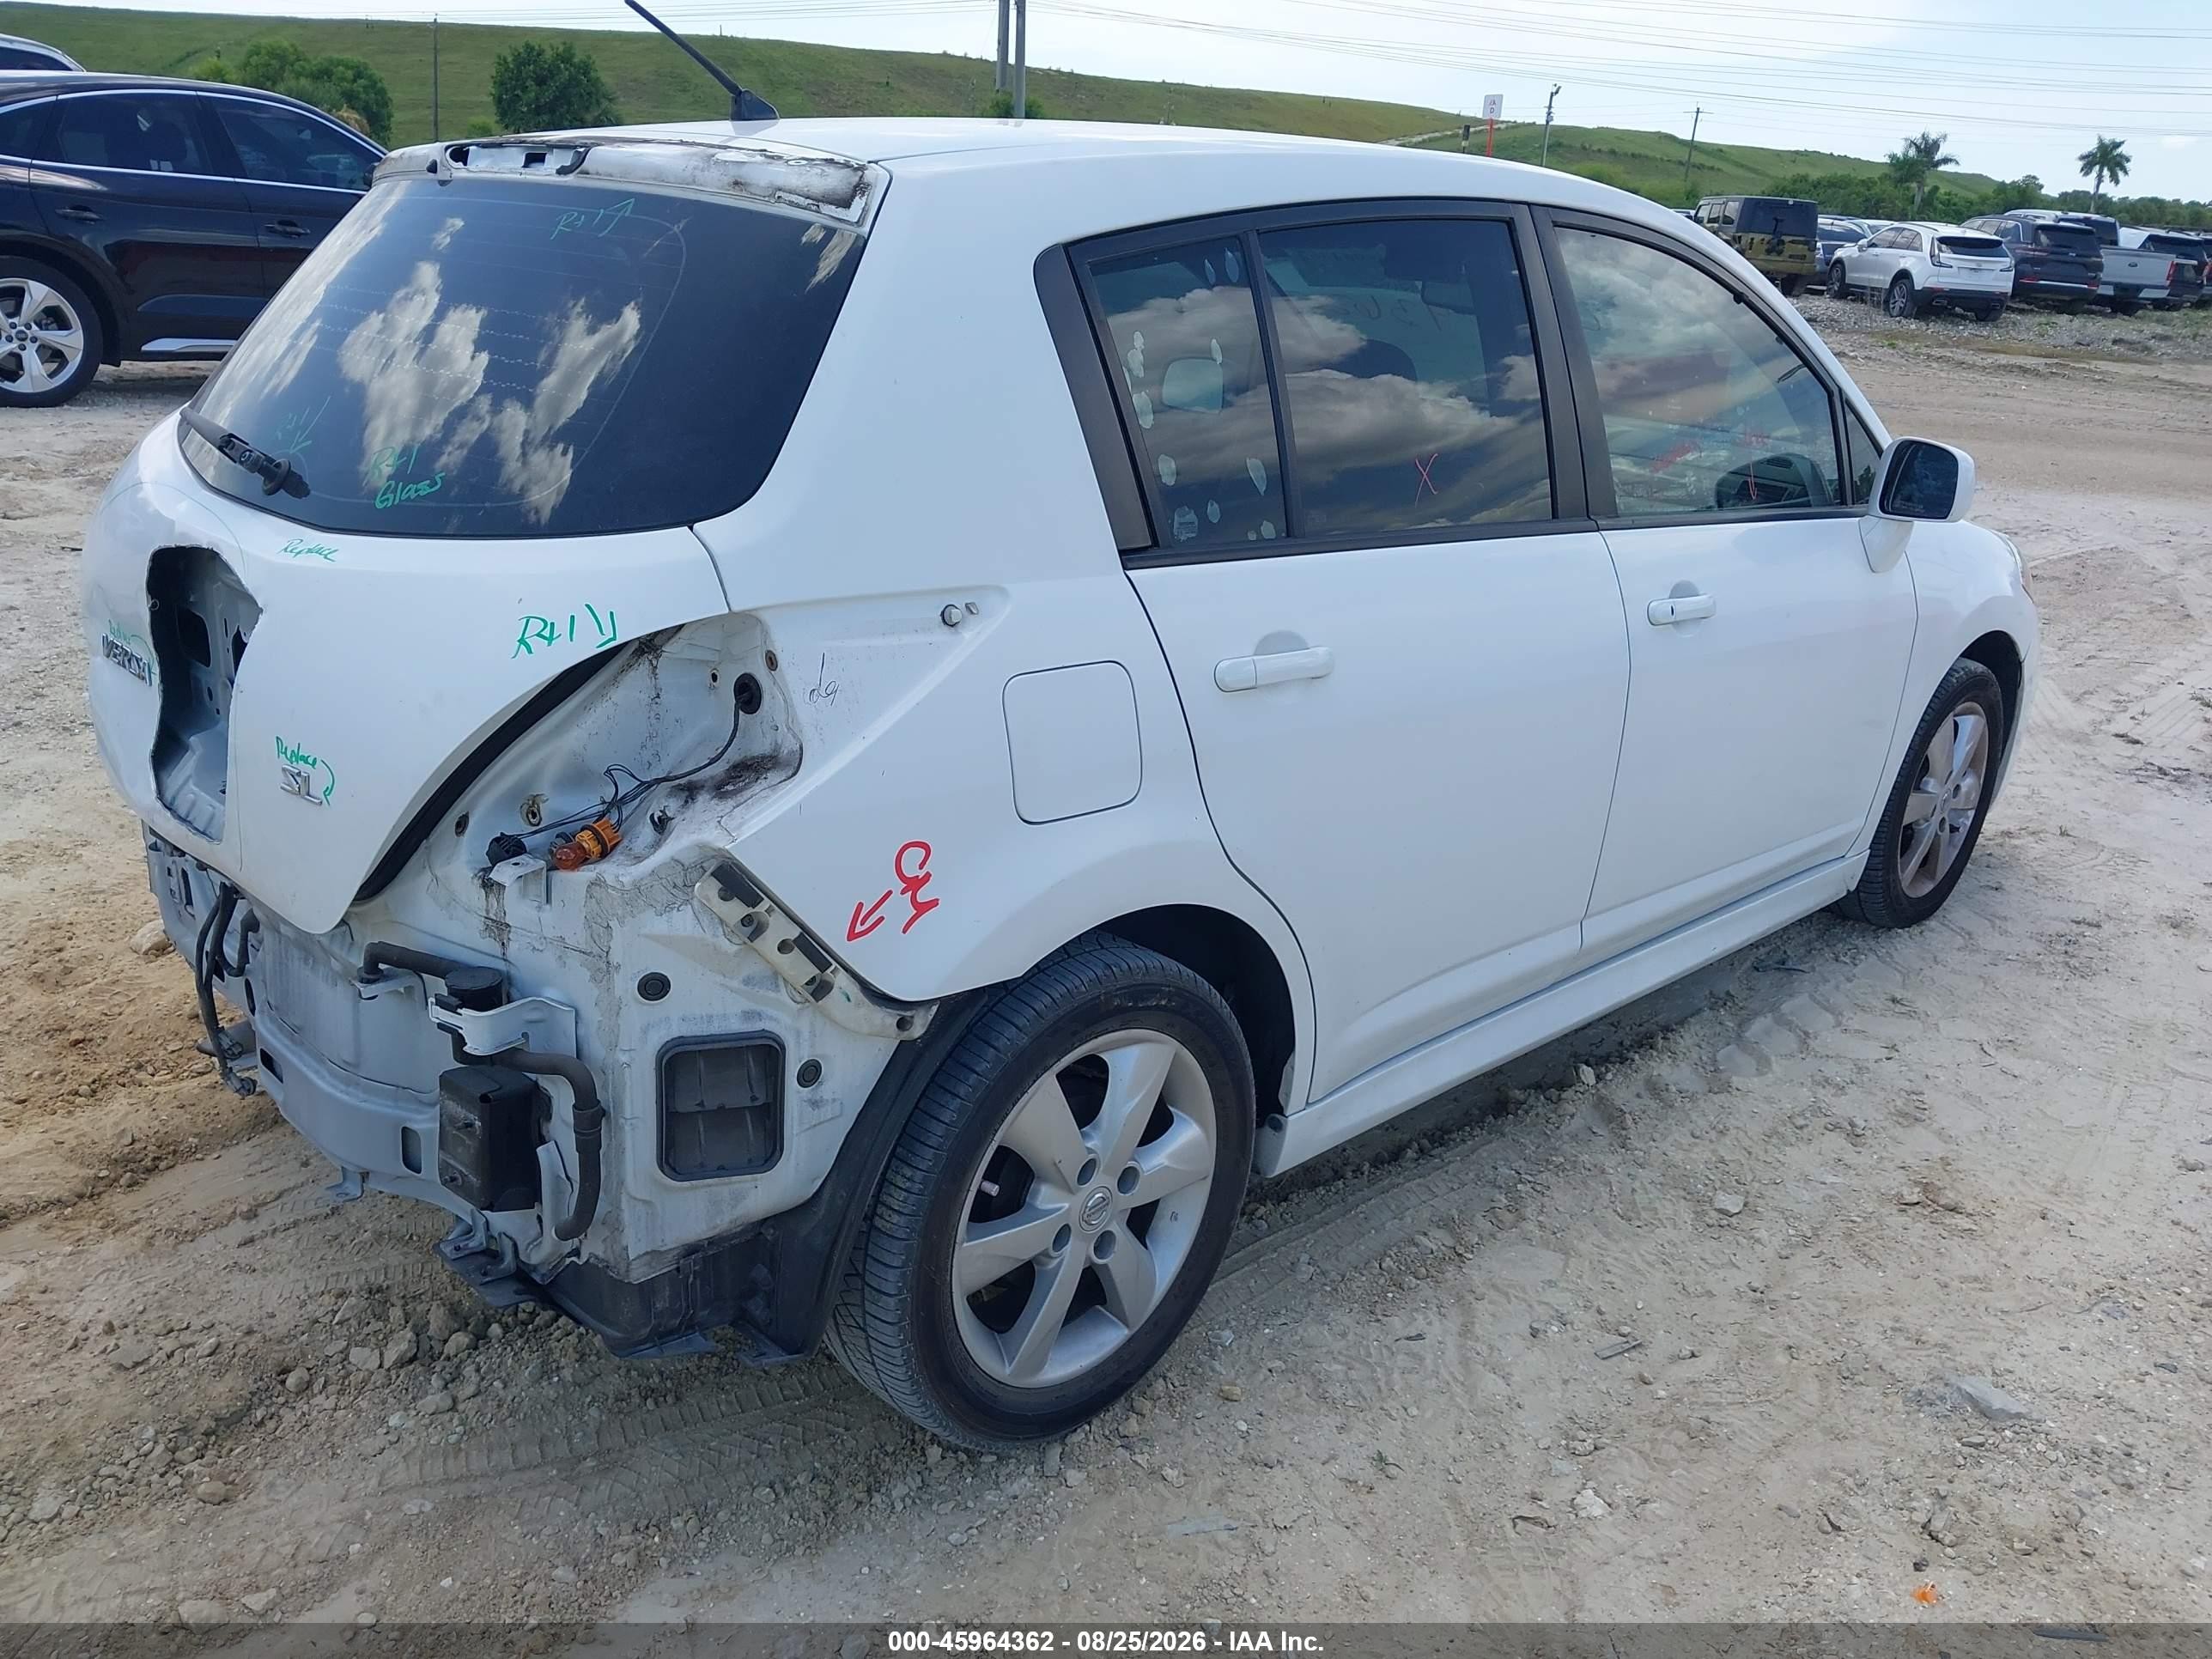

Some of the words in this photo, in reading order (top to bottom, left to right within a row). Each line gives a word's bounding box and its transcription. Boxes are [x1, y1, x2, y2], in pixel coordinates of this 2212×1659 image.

[374, 472, 446, 509] Glass
[101, 632, 153, 688] VERSA
[280, 763, 323, 806] SL
